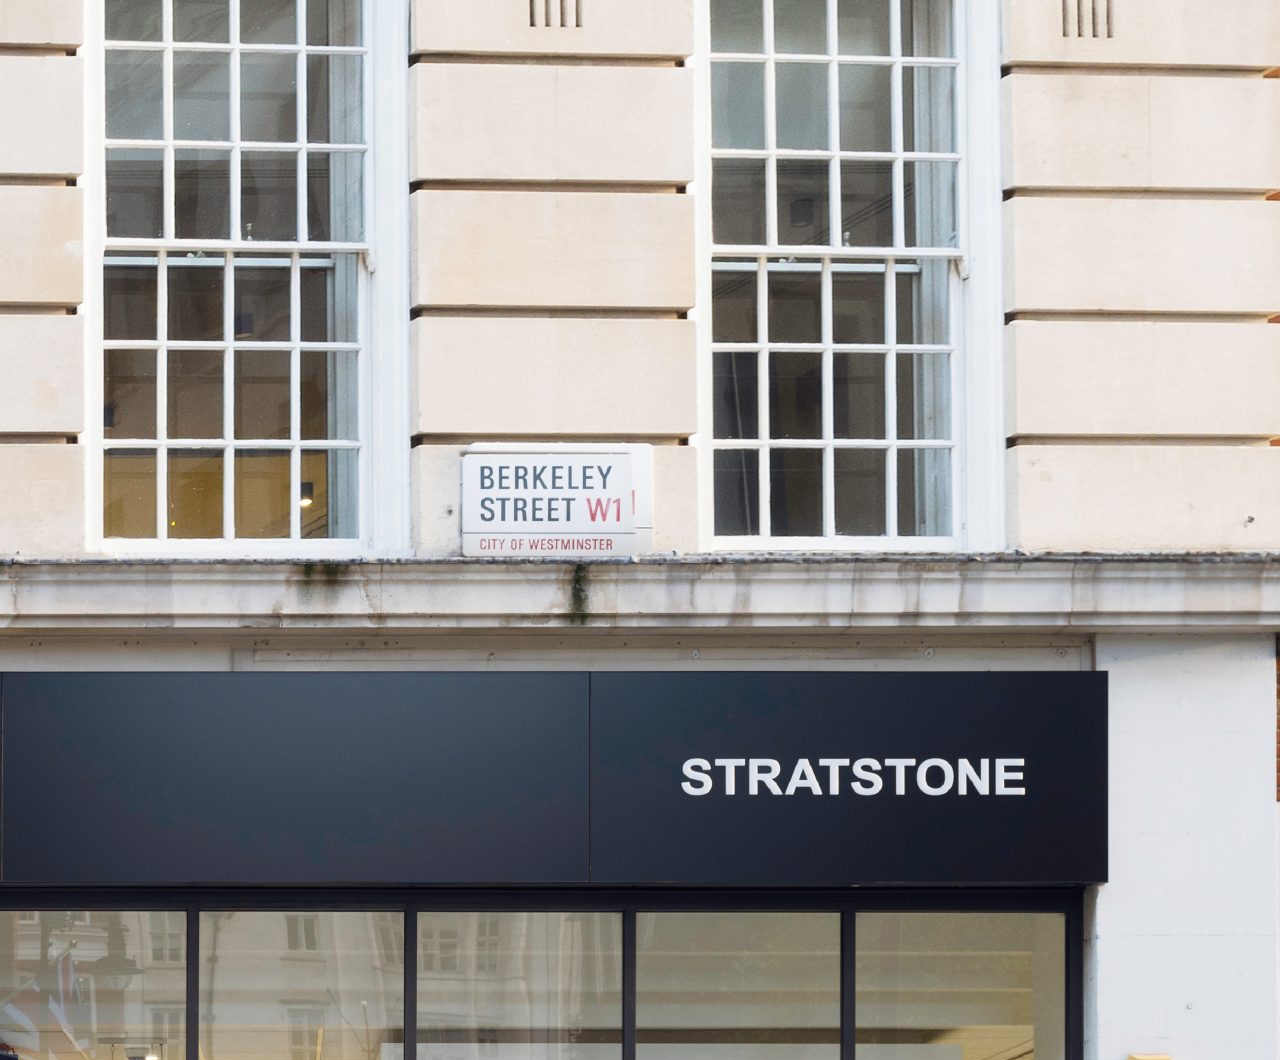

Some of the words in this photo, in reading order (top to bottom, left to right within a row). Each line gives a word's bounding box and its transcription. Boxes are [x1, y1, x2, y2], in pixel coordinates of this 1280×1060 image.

[479, 465, 613, 490] BERKELEY
[479, 497, 576, 522] STREET
[586, 497, 621, 523] W1
[479, 538, 505, 550] CITY
[510, 538, 524, 550] OF
[528, 538, 613, 550] WESTMINSTER
[680, 757, 1026, 796] STRATSTONE
